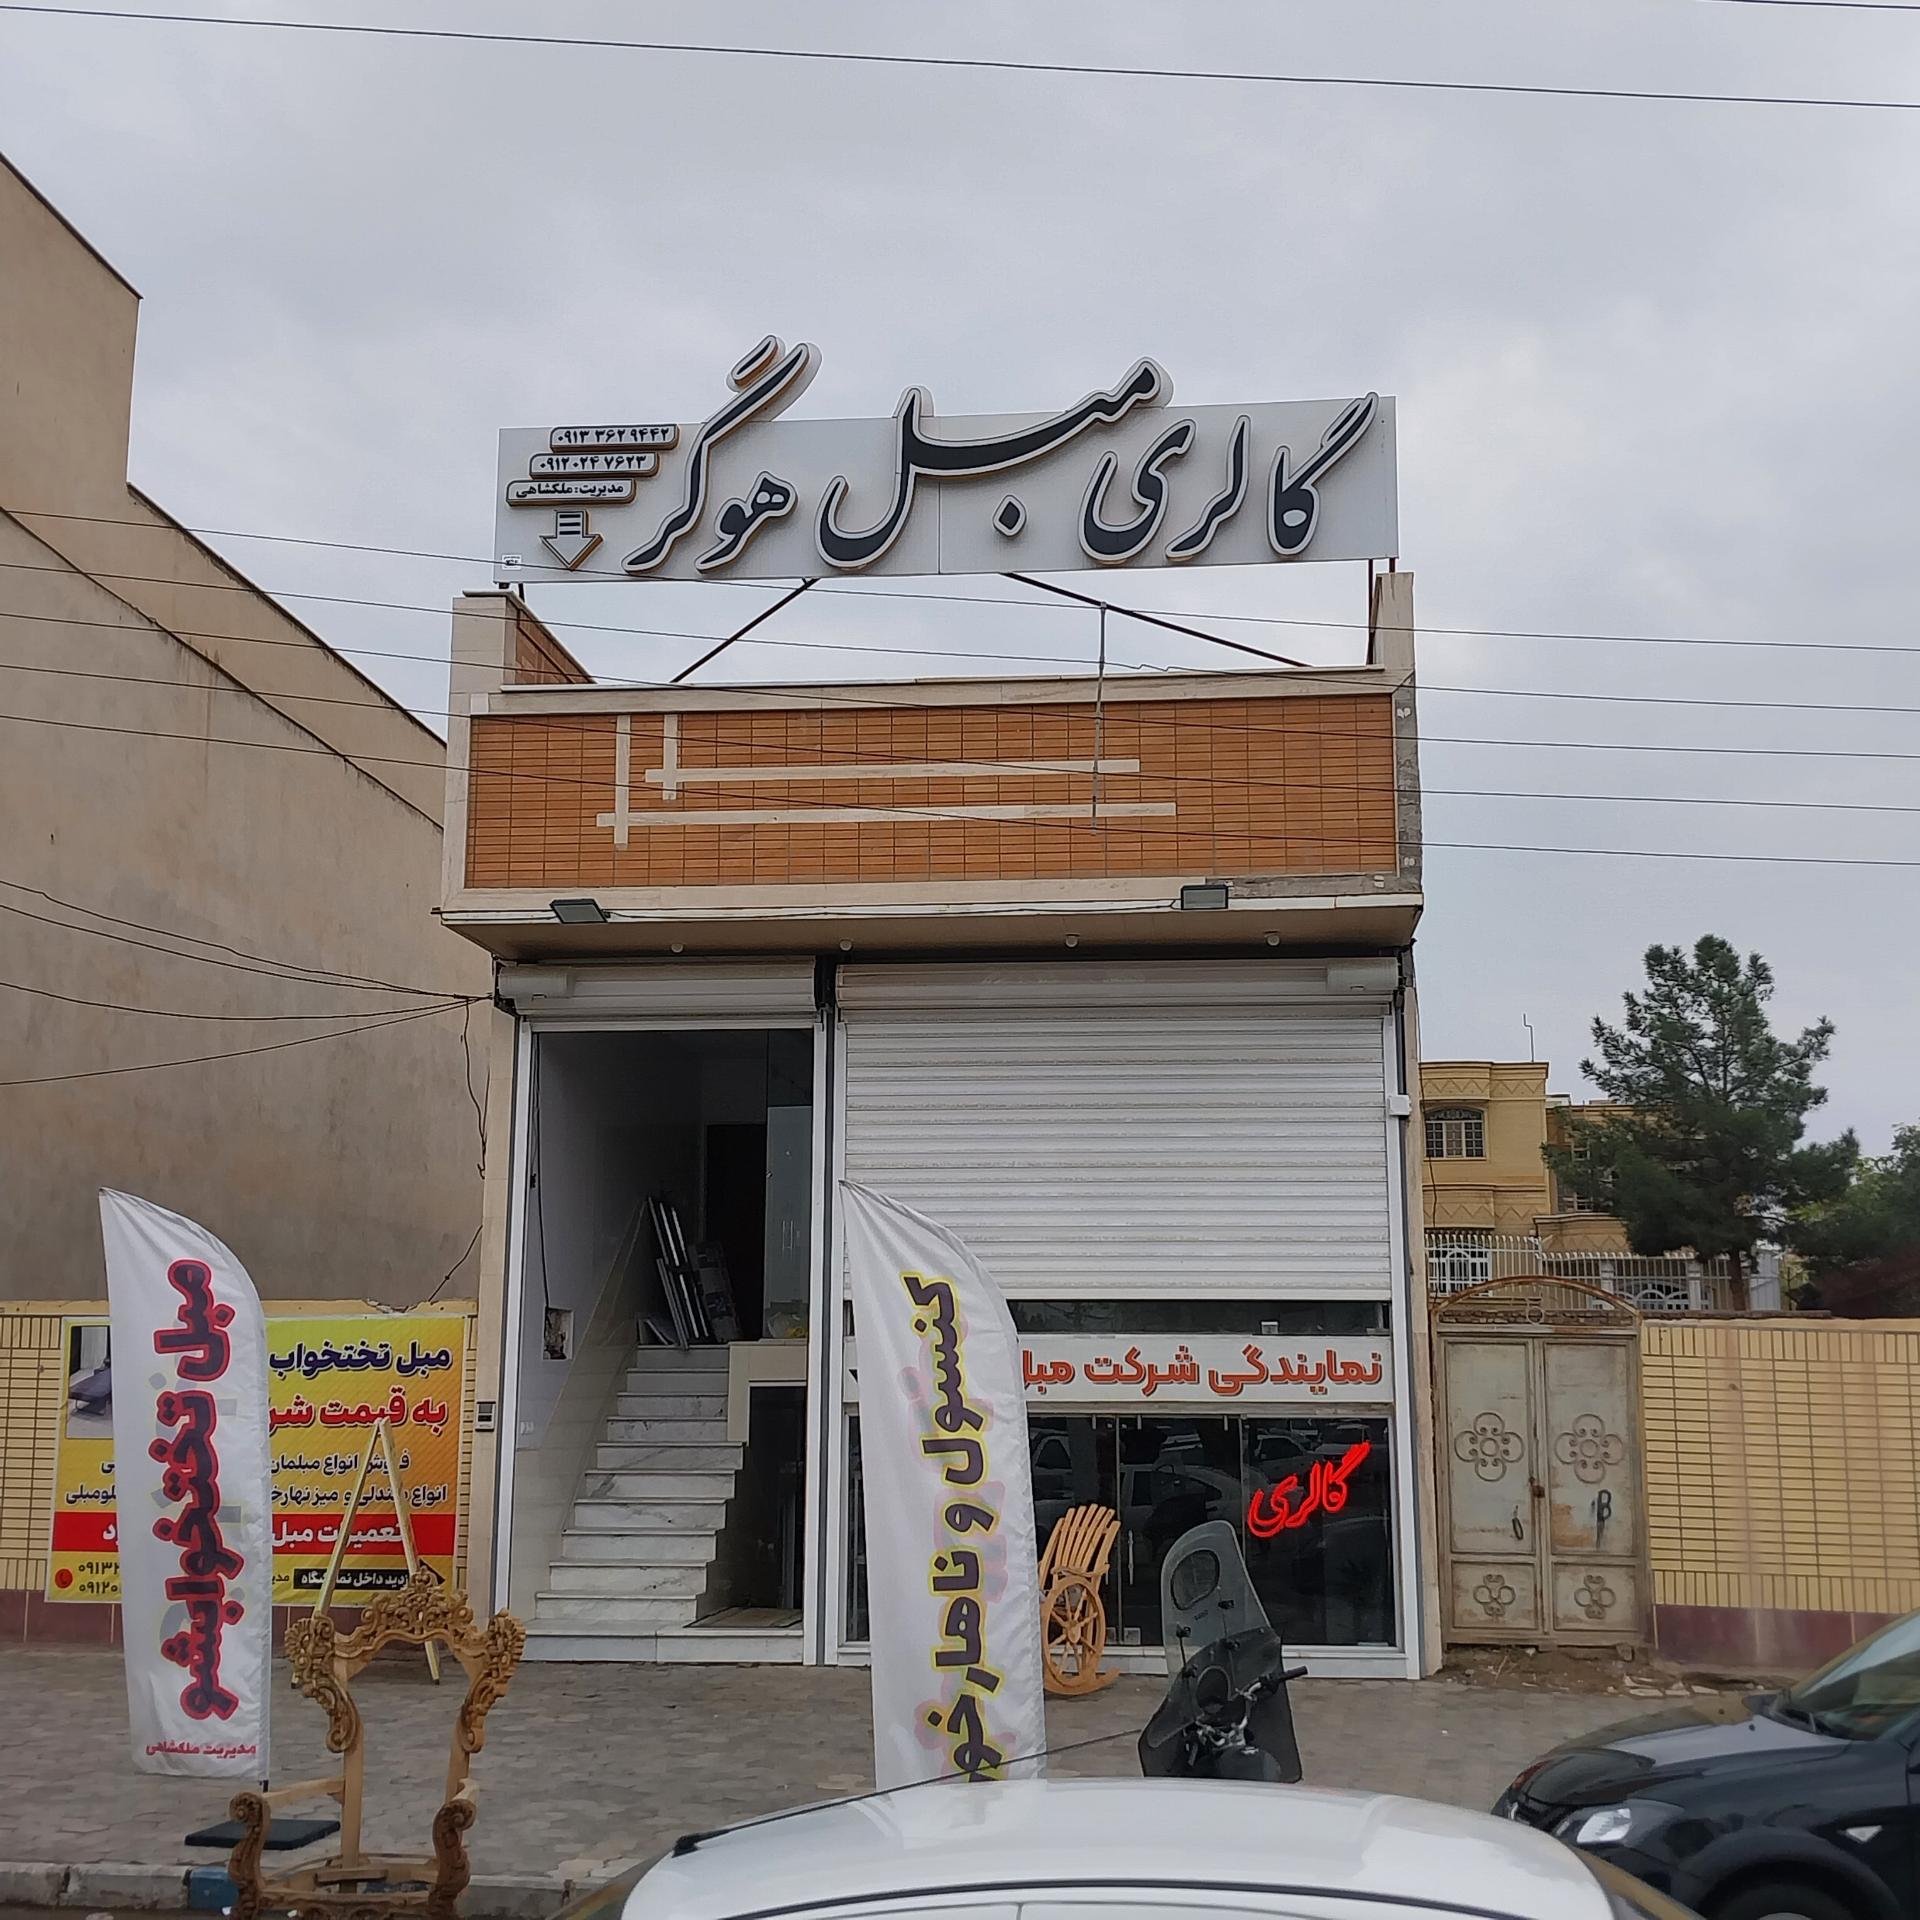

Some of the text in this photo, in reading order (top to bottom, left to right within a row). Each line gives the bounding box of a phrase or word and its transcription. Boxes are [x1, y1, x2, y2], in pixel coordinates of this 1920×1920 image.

[557, 430, 590, 444] ۰۹۱۳
[630, 427, 669, 442] ۹۴۴۲
[816, 358, 1162, 568] مبل
[1080, 392, 1378, 563] گالری
[515, 482, 574, 499] ملکشاهی
[153, 1259, 235, 1382] مبل
[269, 1339, 453, 1380] مبل تختخواب
[1083, 1345, 1200, 1396] شرکت
[1208, 1343, 1383, 1396] نمایندگی
[269, 1386, 449, 1437] به قیمت شر
[271, 1454, 320, 1474] مبلمان
[323, 1454, 358, 1476] انواع
[272, 1485, 311, 1506] نهارخ
[411, 1485, 447, 1507] انواع
[1247, 1440, 1372, 1539] گالری
[272, 1520, 315, 1549] مبل
[902, 1274, 1003, 1783] کنسول و ناهارخو
[79, 1581, 121, 1594] ۰۹۱۲۰
[353, 1571, 383, 1587] داخل
[145, 1740, 257, 1759] مدیریت ملکشاهی
